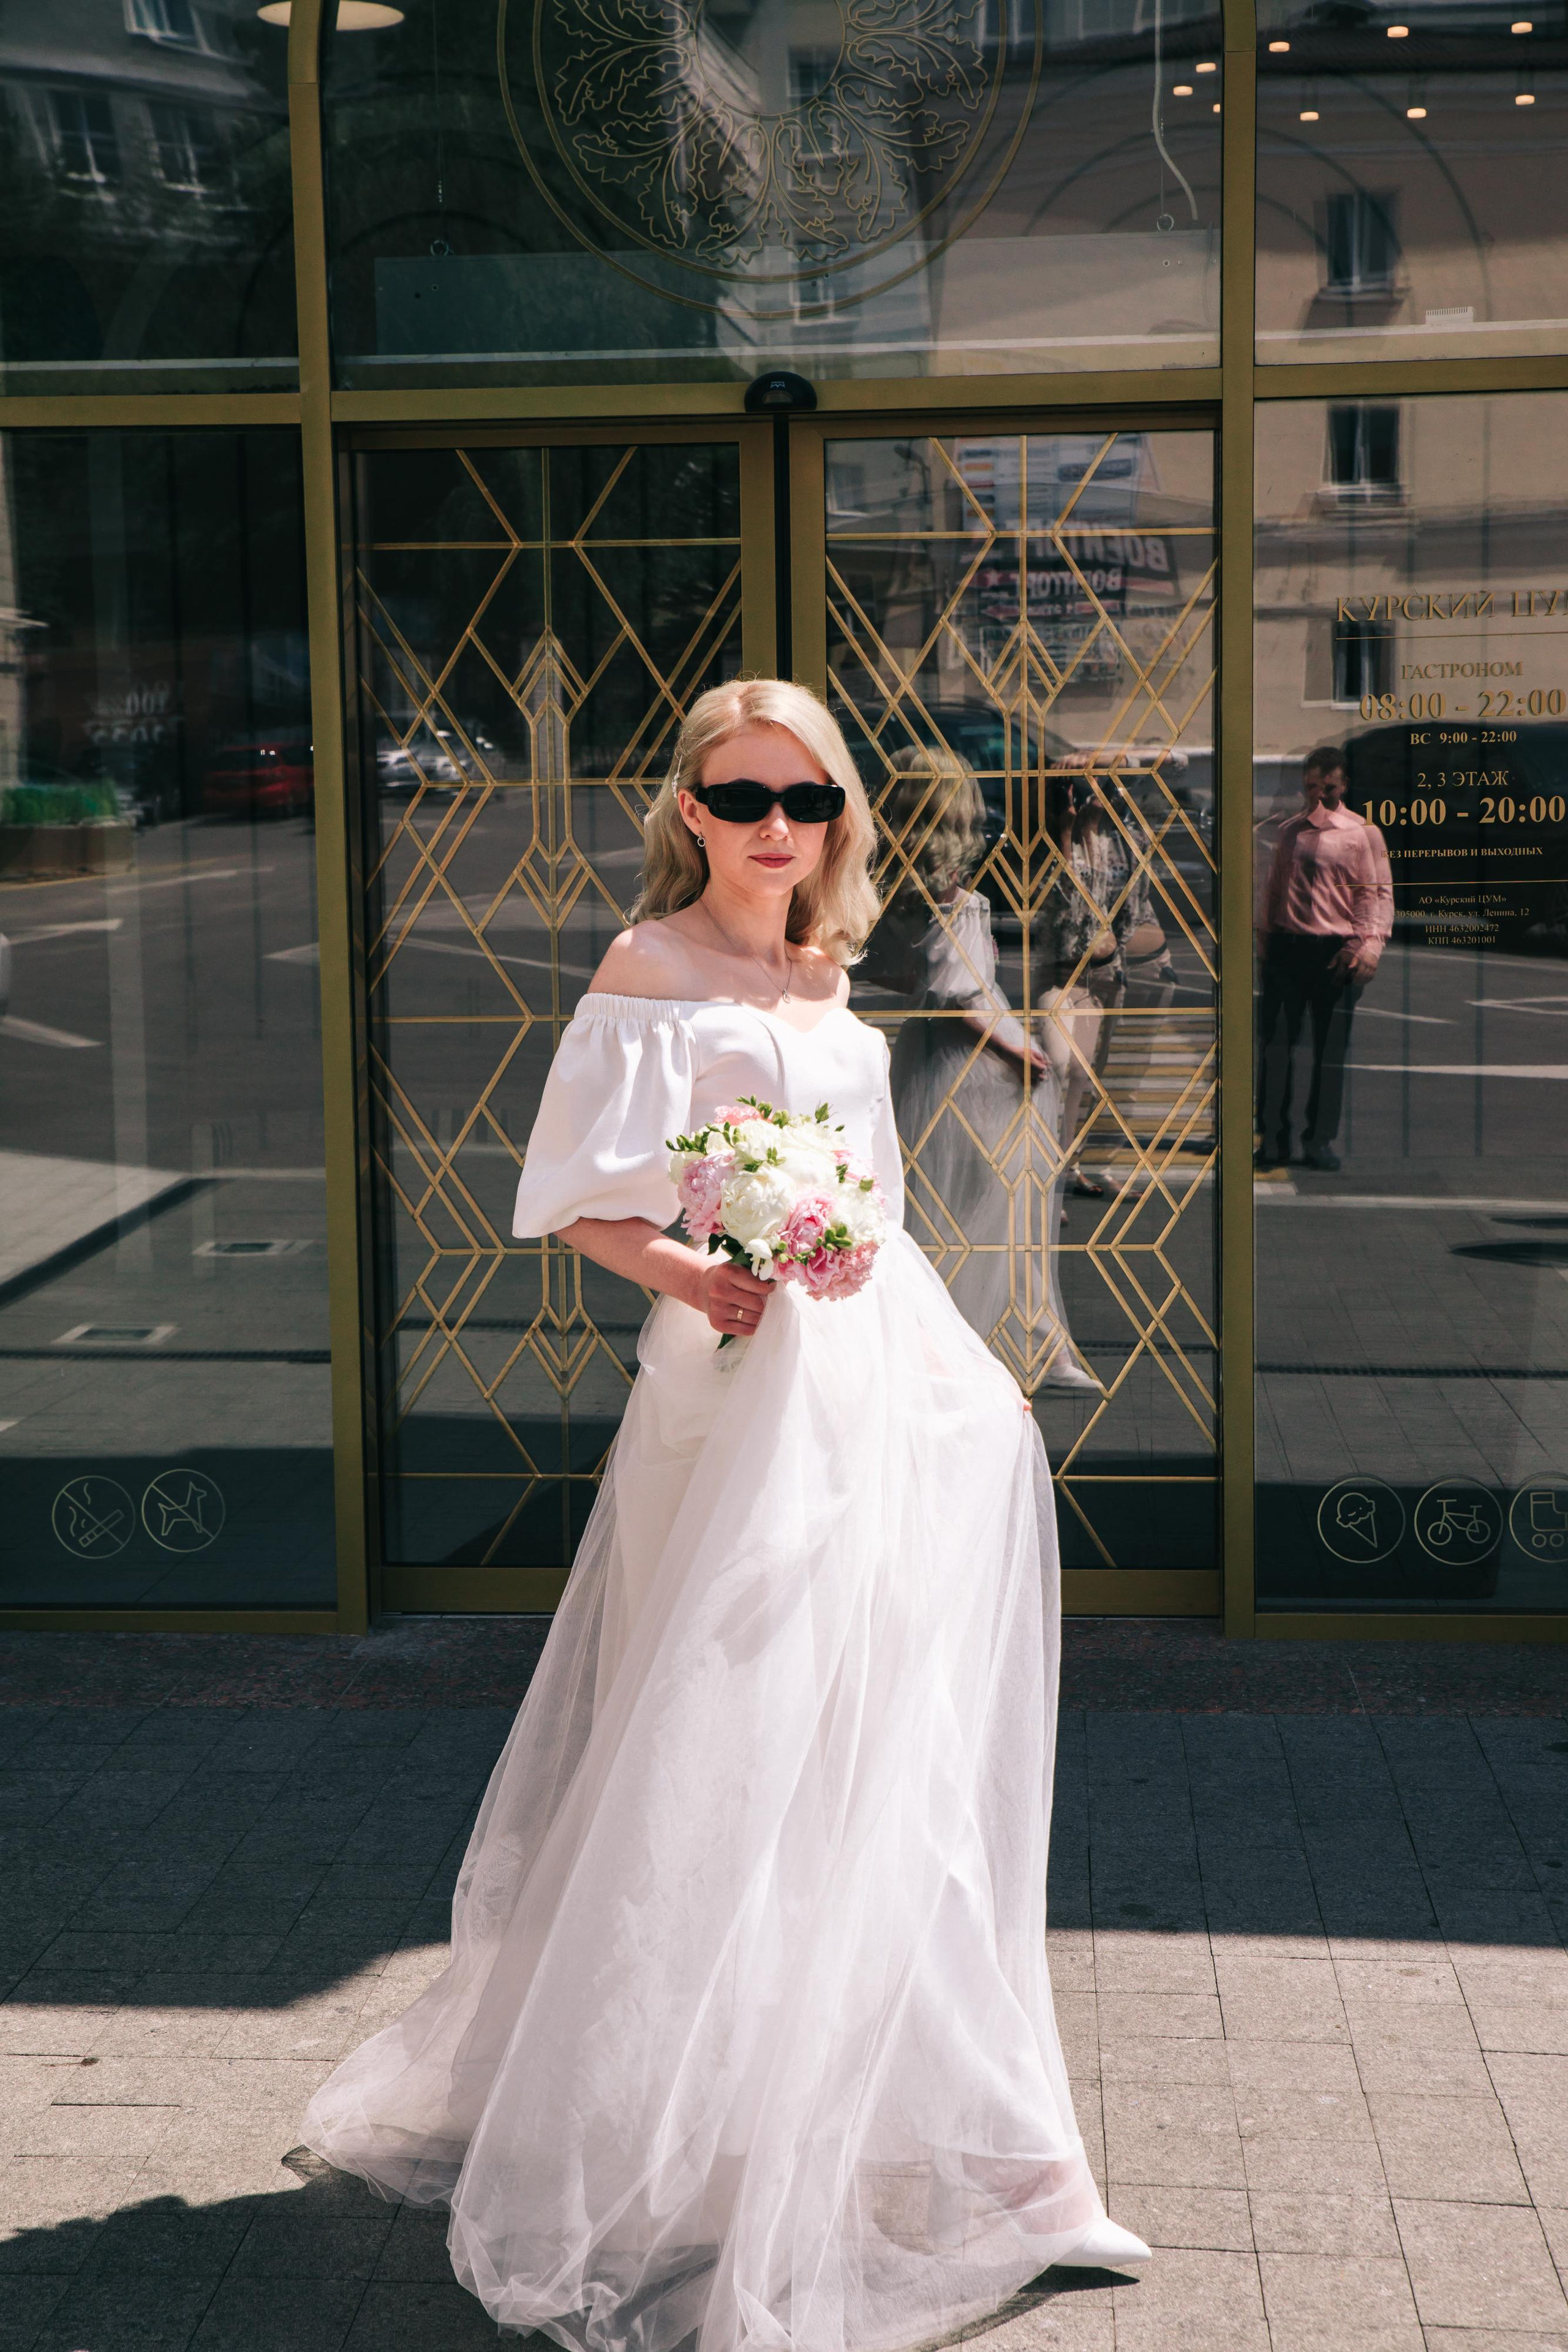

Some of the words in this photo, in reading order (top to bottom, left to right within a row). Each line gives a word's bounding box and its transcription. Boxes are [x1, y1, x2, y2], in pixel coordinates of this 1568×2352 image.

[1335, 590, 1496, 622] КУРСКИЙ
[1401, 661, 1524, 679] ГАСТРОНОМ
[1360, 692, 1446, 720] 08:00
[1478, 688, 1567, 718] 22:00
[1410, 733, 1431, 745] ВС
[1439, 732, 1468, 744] 9:00
[1481, 731, 1517, 743] 22:00
[1417, 773, 1432, 790] 2,
[1437, 772, 1446, 787] 3
[1452, 771, 1509, 786] ЭТАЖ
[1362, 798, 1447, 826] 10:00
[1479, 796, 1566, 824] 20:00
[1404, 849, 1468, 858] ПЕРЕРЫВОВ
[1481, 847, 1544, 857] ВЫХОДНЫХ
[1418, 896, 1433, 905] АО
[1434, 895, 1476, 906] «Курский
[1479, 894, 1507, 904] ЦУМ»
[1468, 911, 1480, 919] ул.
[1520, 908, 1530, 916] 12
[1425, 925, 1447, 933] ИНН
[1449, 924, 1499, 933] 4632002472
[1428, 937, 1449, 945] КПП
